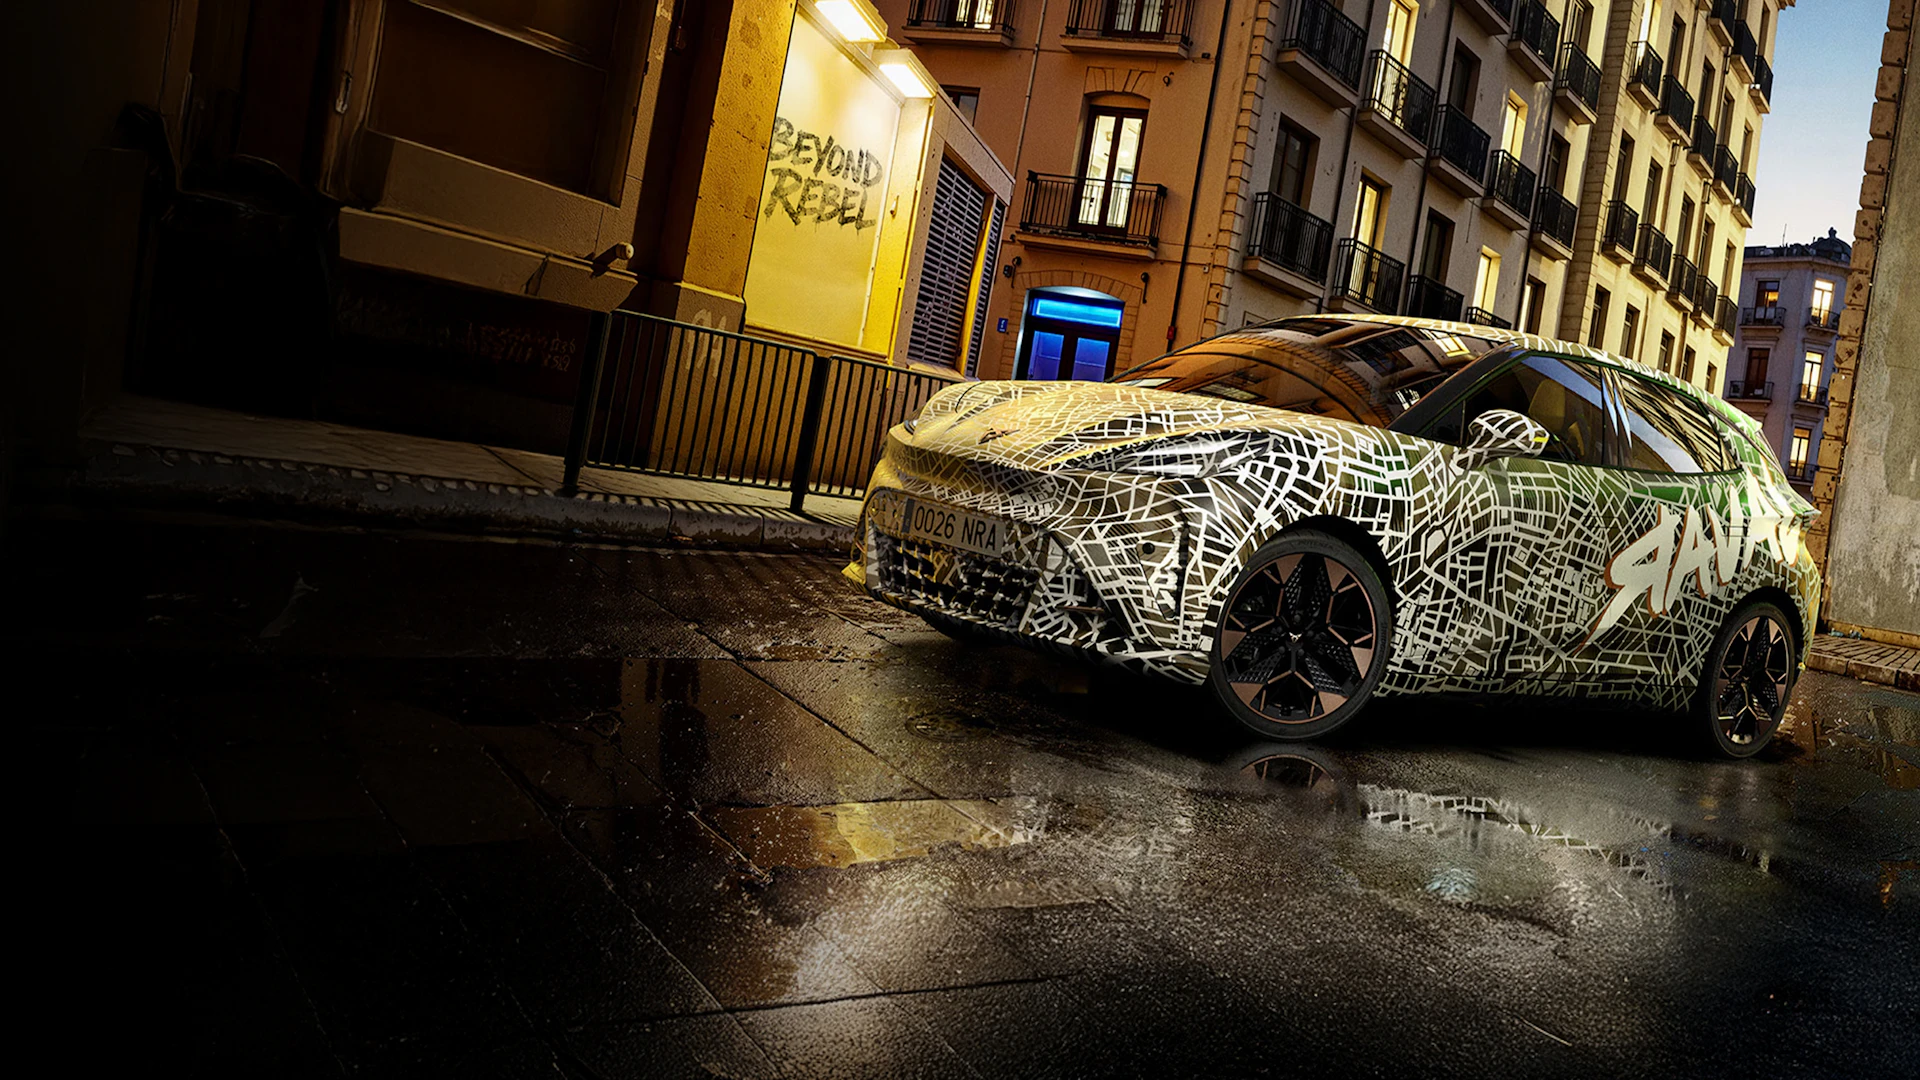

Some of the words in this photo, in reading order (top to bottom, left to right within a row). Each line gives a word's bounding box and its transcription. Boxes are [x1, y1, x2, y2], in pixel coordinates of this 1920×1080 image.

[769, 116, 883, 188] BEYOND
[764, 167, 877, 232] REBEL
[914, 505, 956, 539] 0026
[961, 517, 996, 551] NRA
